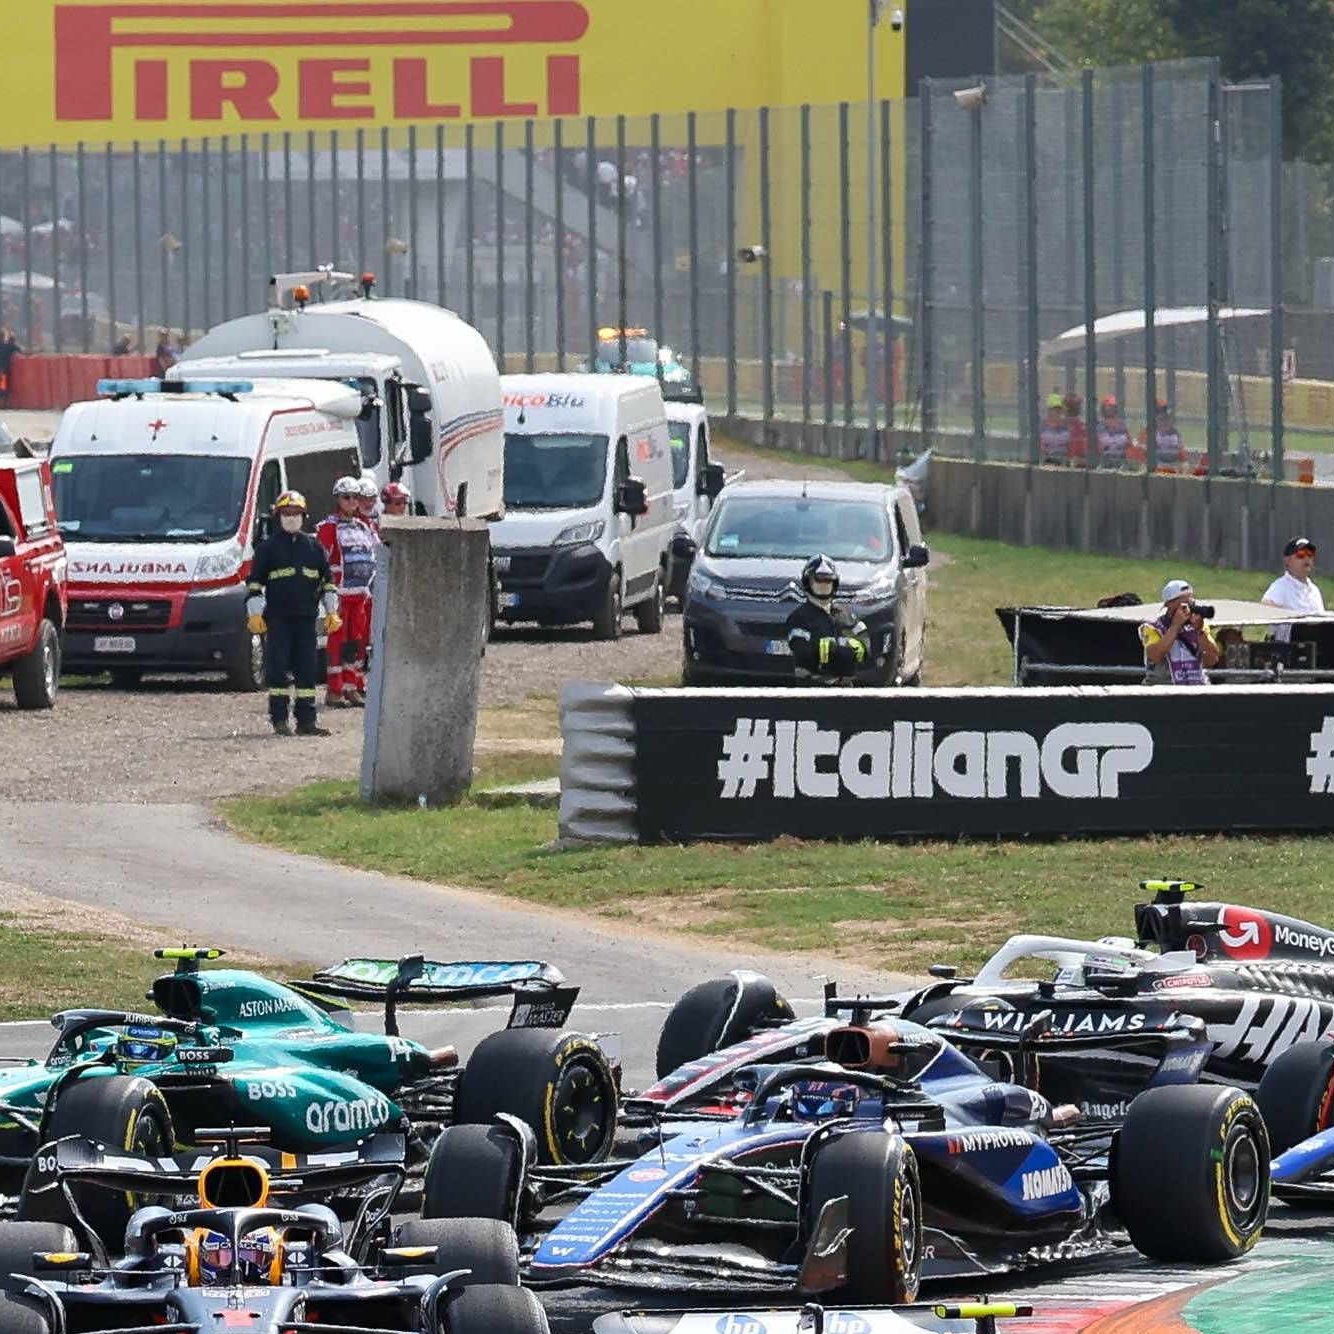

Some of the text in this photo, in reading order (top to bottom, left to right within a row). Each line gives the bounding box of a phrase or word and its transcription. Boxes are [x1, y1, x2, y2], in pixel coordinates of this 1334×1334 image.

[54, 2, 589, 121] PIRELLI
[717, 717, 1154, 799] #ItalianGP
[239, 1001, 273, 1018] ASTON
[180, 1050, 210, 1061] BOSS
[248, 1081, 297, 1101] BOSS
[306, 1098, 390, 1134] aramco
[962, 1133, 1034, 1152] MYPROTEIN
